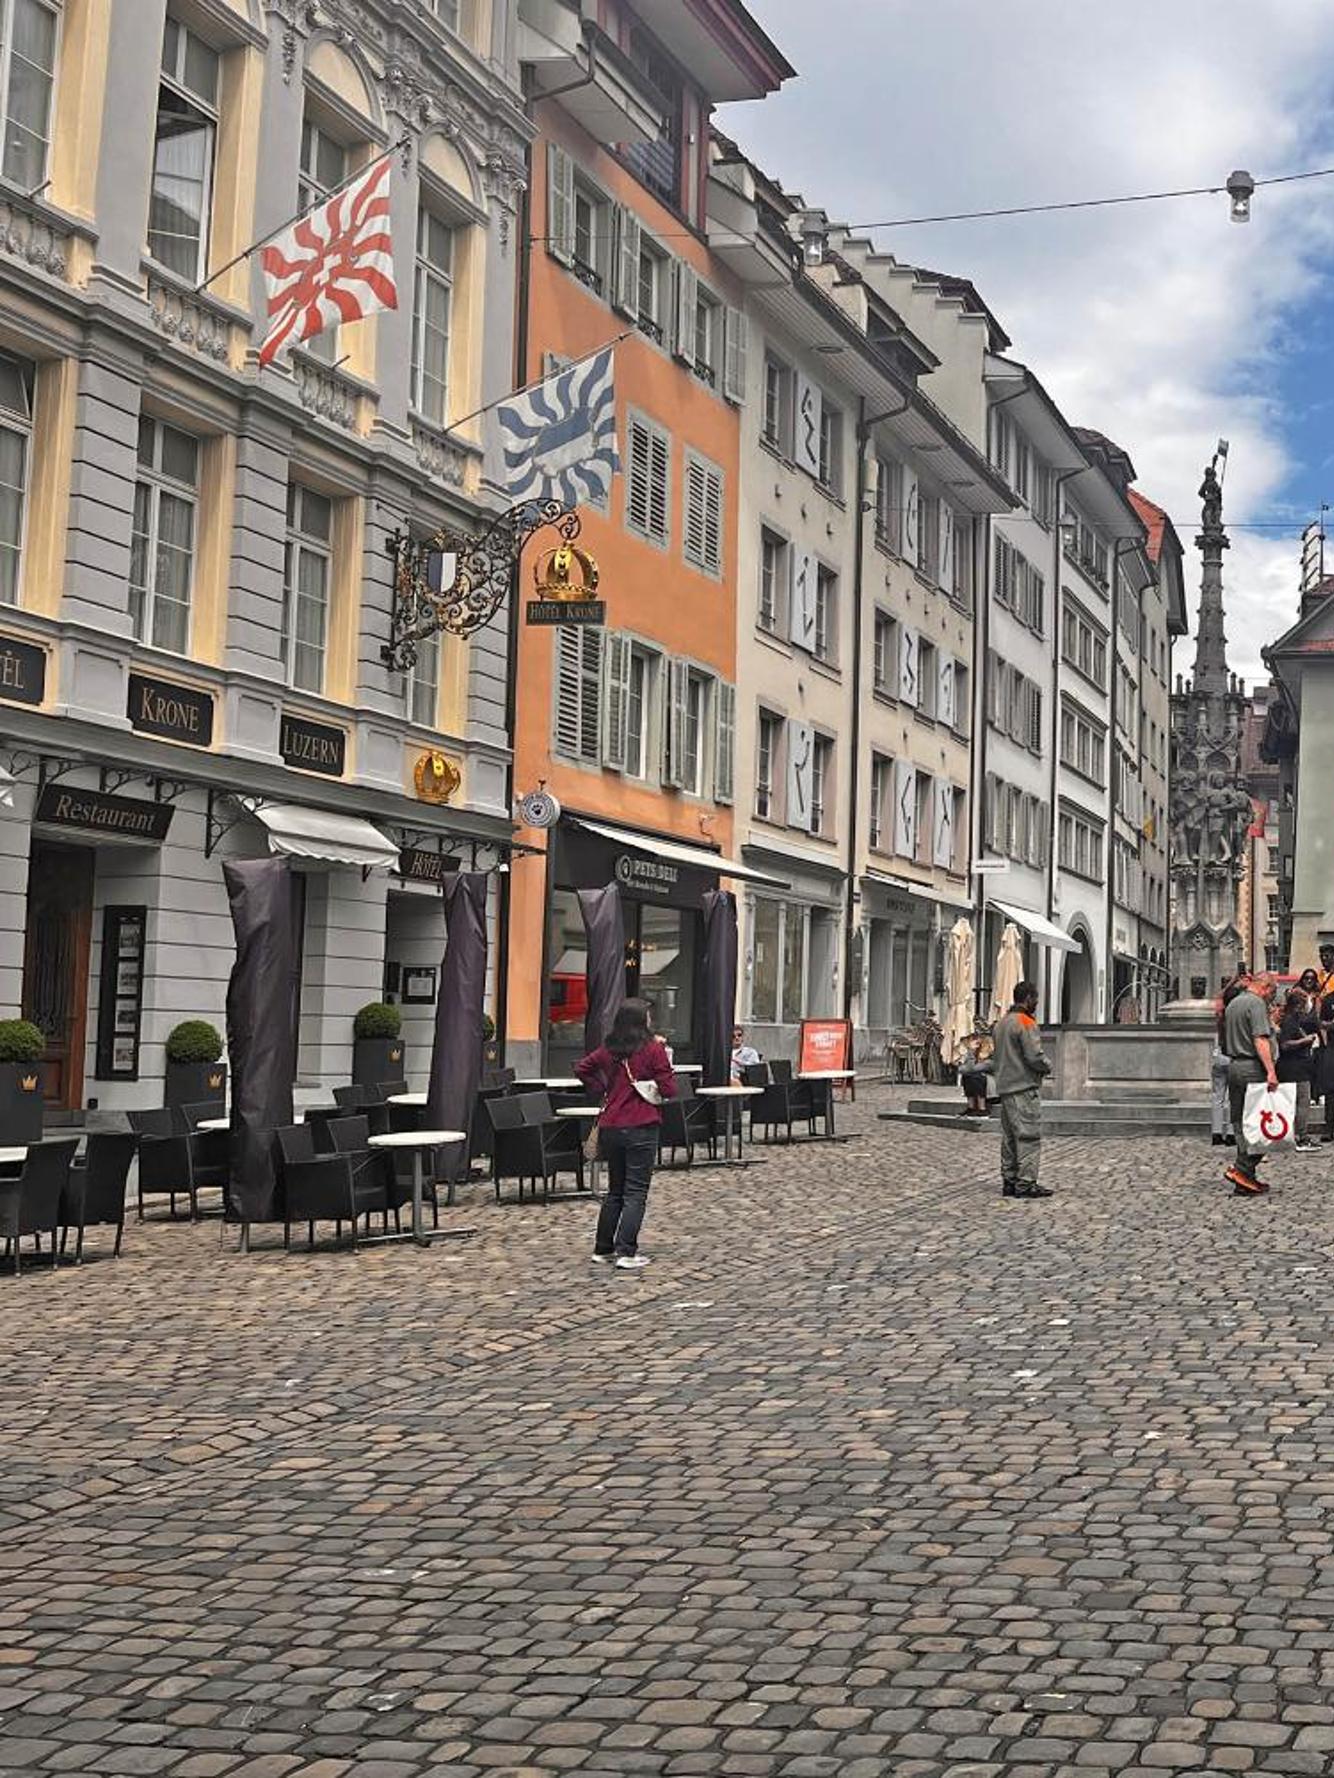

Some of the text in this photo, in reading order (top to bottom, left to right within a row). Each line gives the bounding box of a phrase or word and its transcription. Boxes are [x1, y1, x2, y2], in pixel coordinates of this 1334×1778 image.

[140, 686, 200, 733] KRONE
[284, 724, 340, 764] LUZERN
[55, 794, 156, 832] Restaurant
